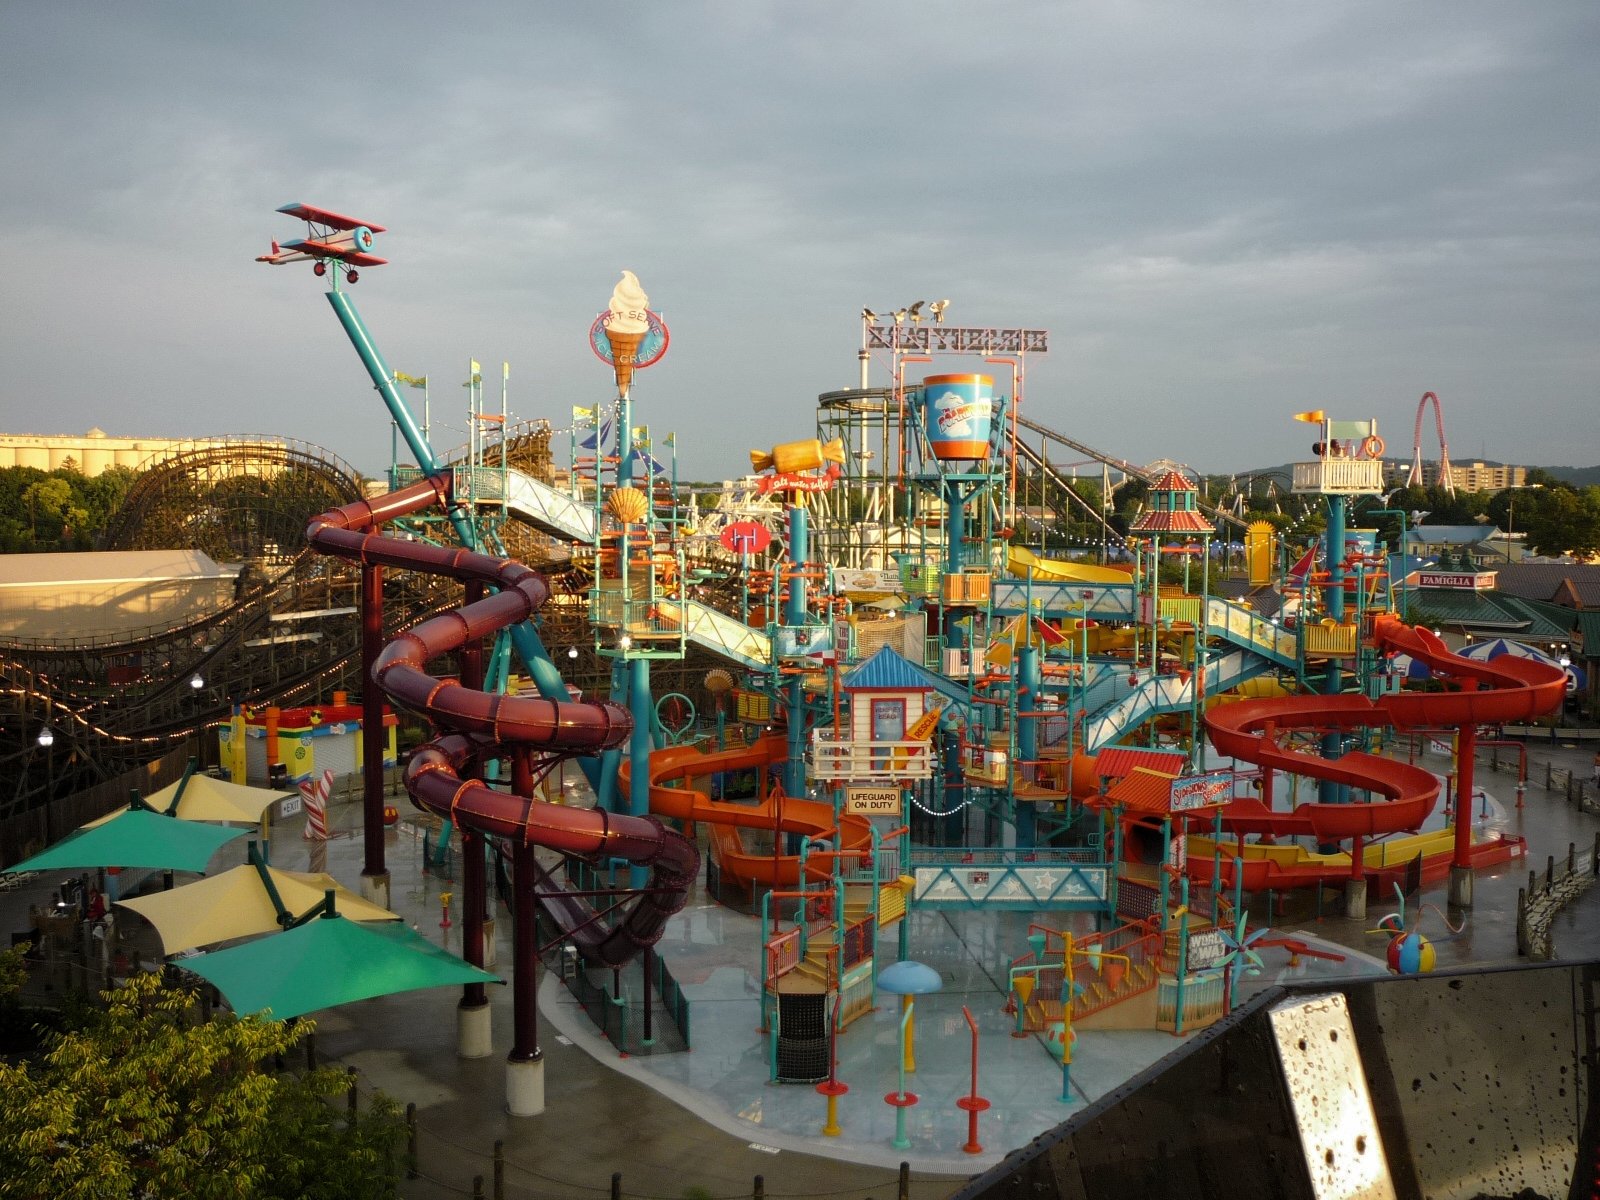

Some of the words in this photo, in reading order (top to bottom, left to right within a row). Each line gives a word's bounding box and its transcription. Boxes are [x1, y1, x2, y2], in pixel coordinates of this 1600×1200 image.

[595, 311, 624, 334] SOFT
[628, 311, 661, 337] SERVE
[595, 340, 614, 359] ICE
[619, 341, 660, 364] CREAM
[938, 402, 991, 433] BOARDW
[1423, 576, 1471, 586] FAMIGLIA
[914, 708, 938, 739] RESCUE
[851, 793, 896, 801] LIFEGUARD
[854, 801, 867, 809] ON
[870, 801, 893, 809] DUTY
[1190, 931, 1226, 947] WORL
